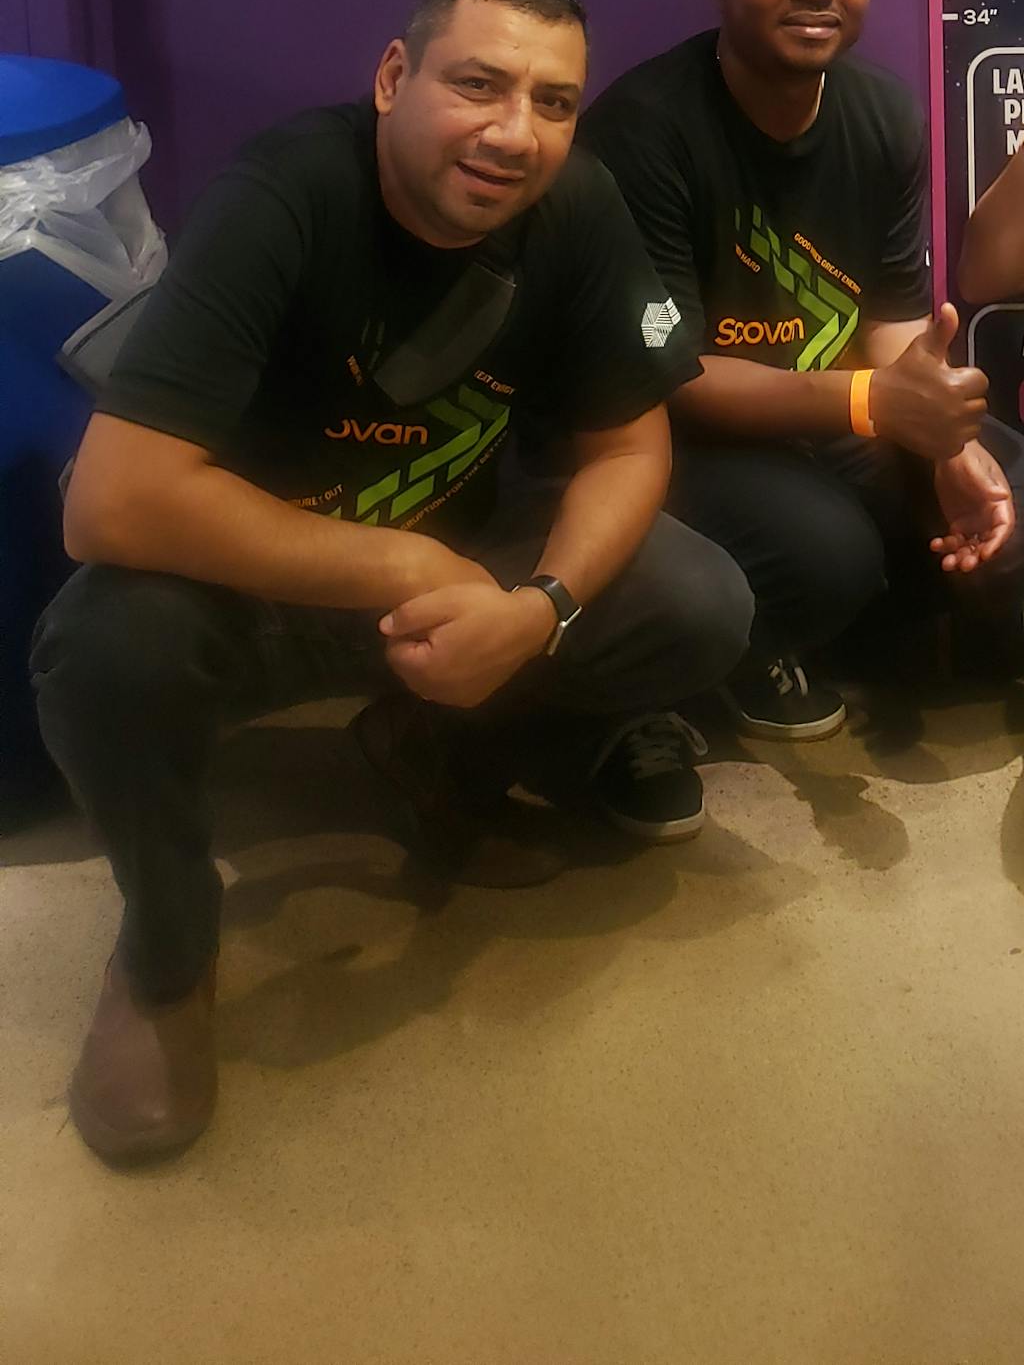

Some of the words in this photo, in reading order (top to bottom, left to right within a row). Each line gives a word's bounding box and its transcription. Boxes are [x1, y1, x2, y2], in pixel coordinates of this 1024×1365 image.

[963, 9, 998, 25] 34"
[793, 232, 811, 251] GOOD
[820, 260, 843, 281] GREAT
[325, 484, 344, 500] OUT
